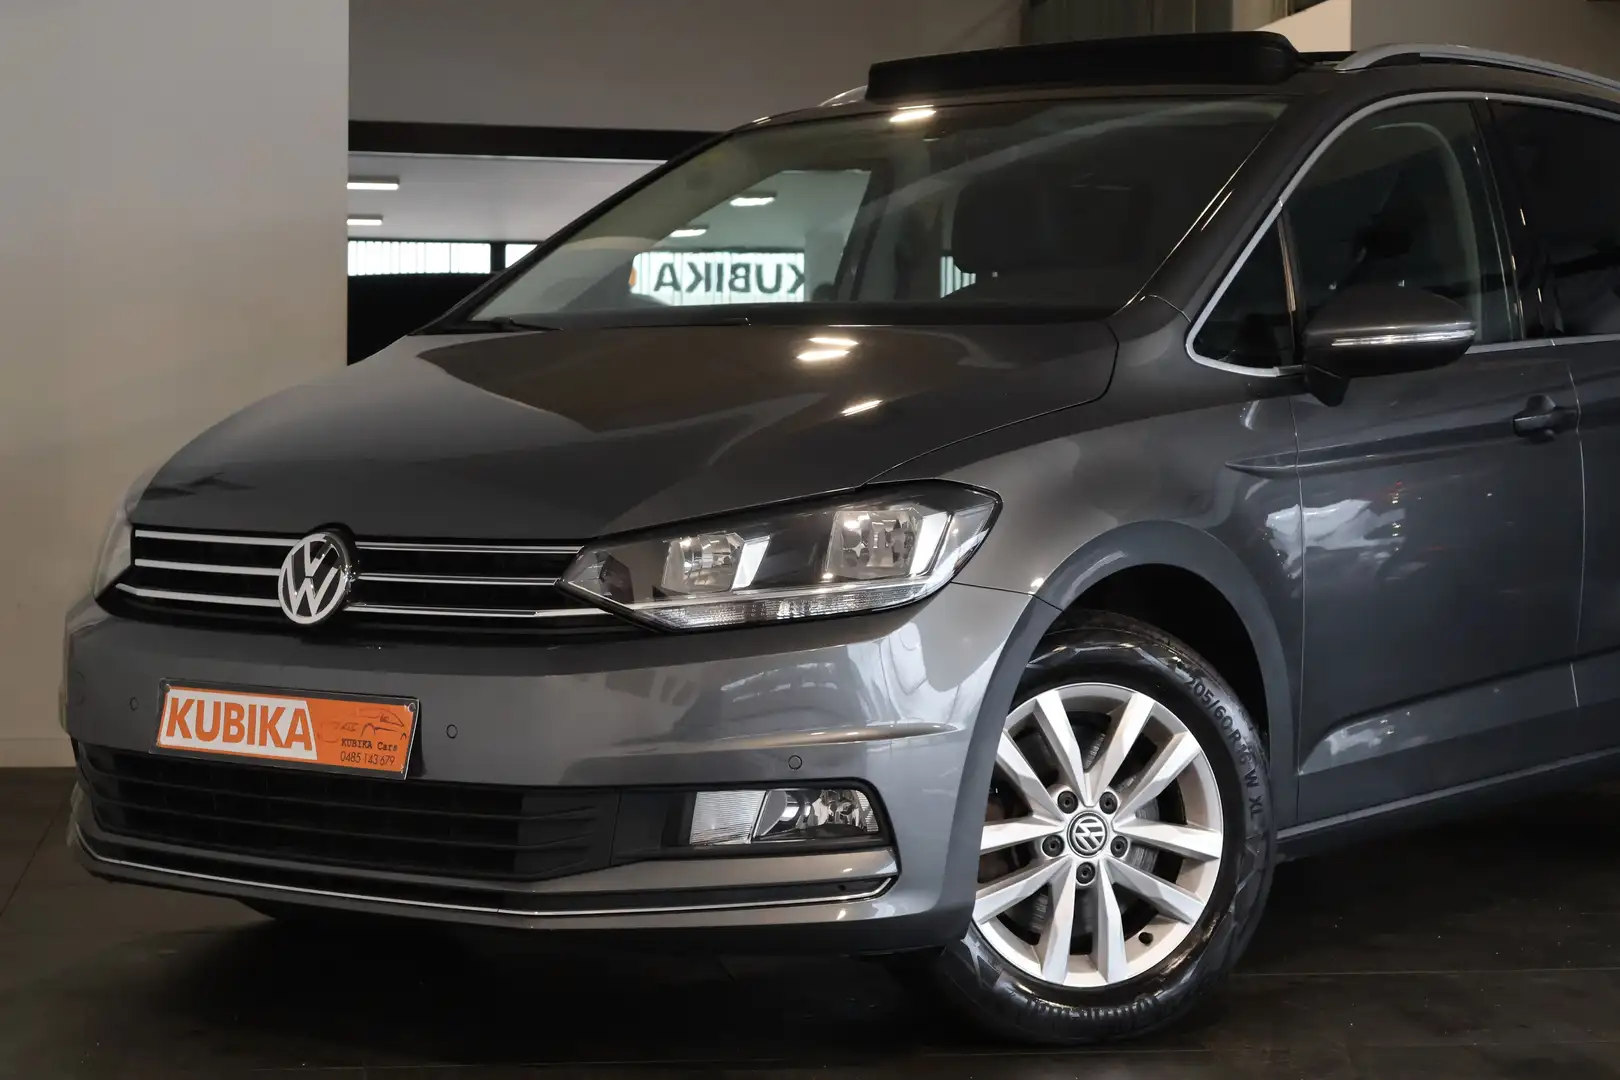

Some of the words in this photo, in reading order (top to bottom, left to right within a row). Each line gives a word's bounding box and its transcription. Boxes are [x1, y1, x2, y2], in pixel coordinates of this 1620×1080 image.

[166, 697, 313, 751] KUBIKA
[341, 738, 372, 750] KUBIKA
[377, 741, 398, 752] Cars
[340, 751, 361, 763] 0485
[364, 753, 379, 765] 143
[380, 755, 395, 766] 679
